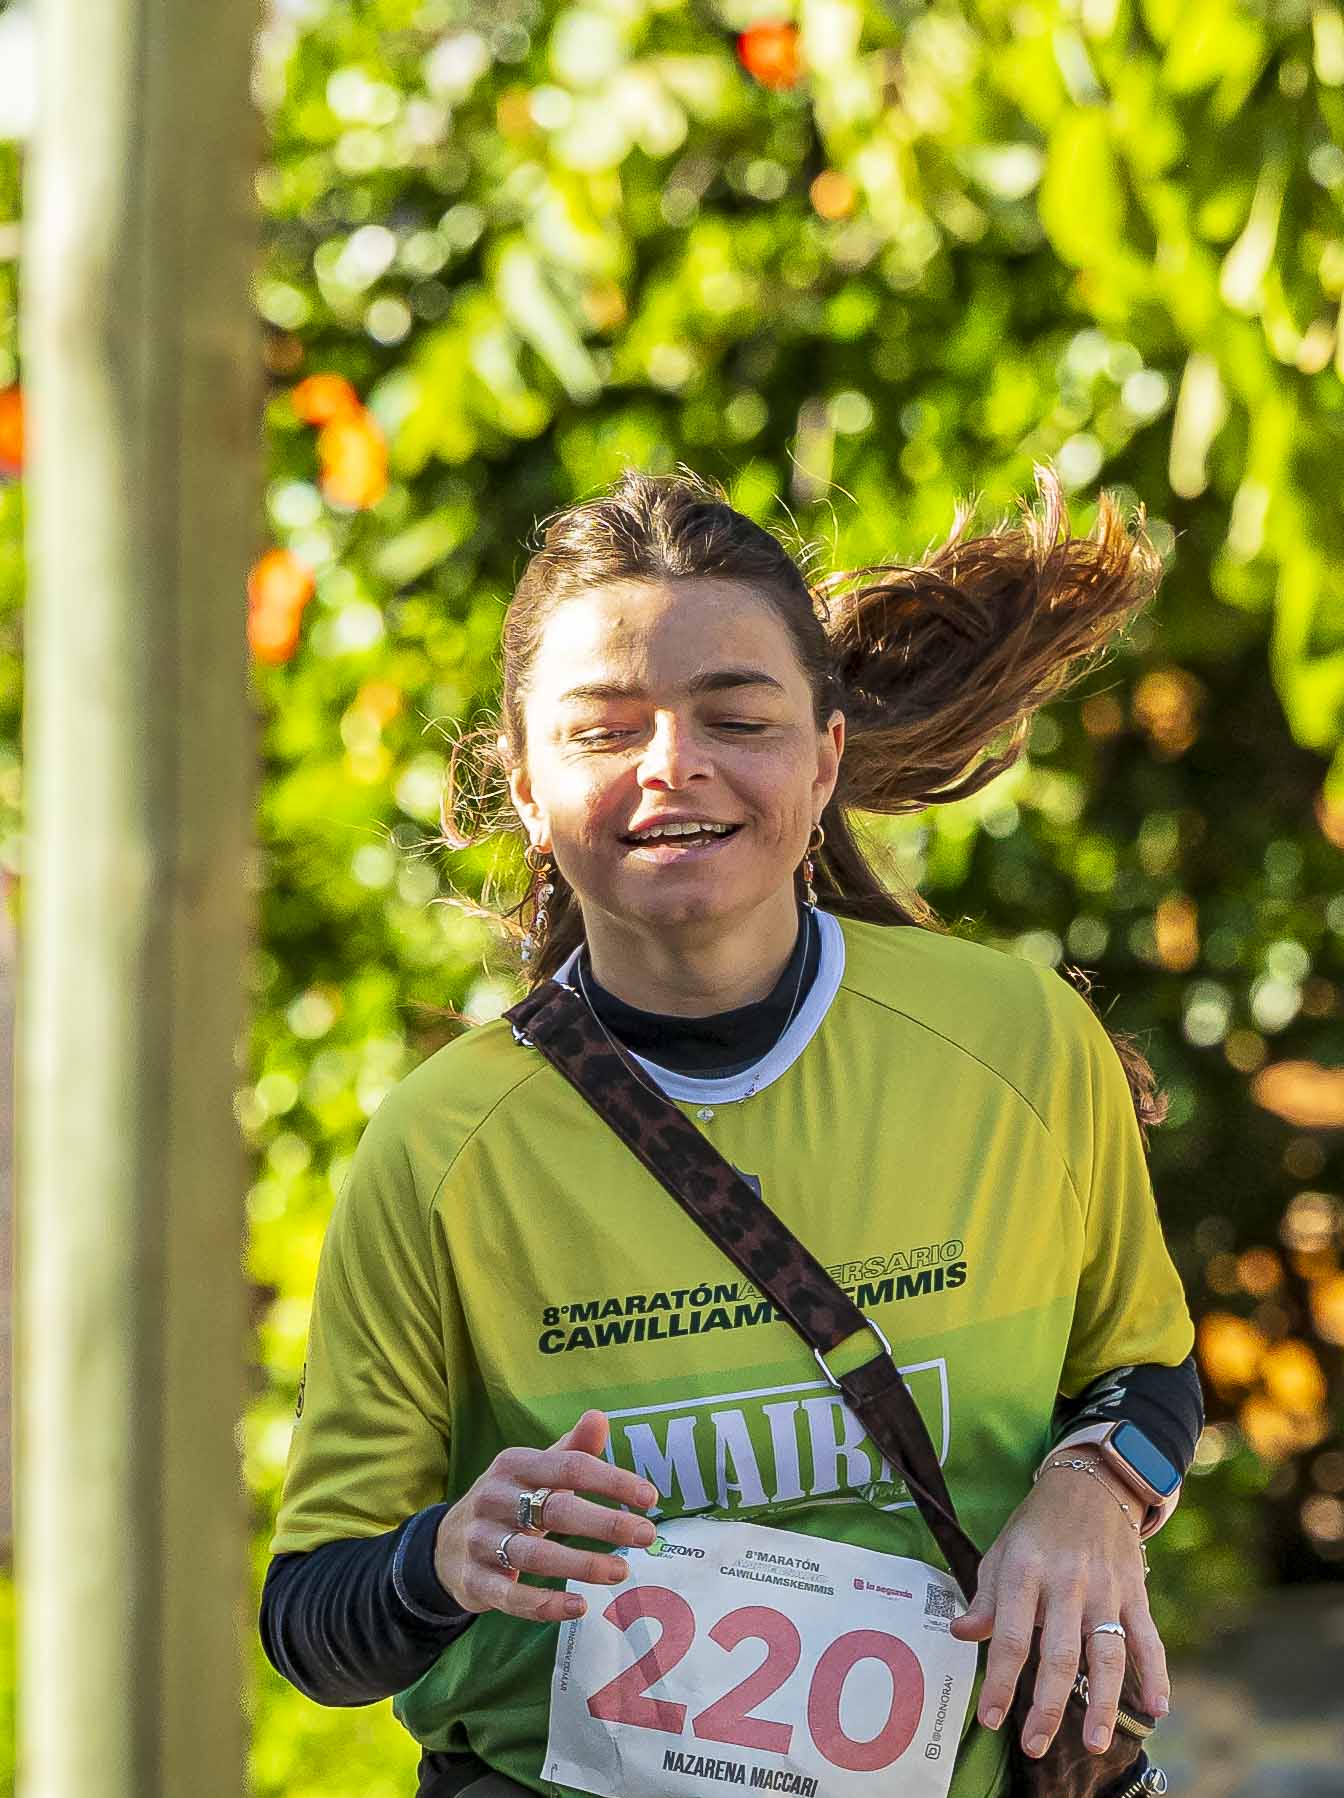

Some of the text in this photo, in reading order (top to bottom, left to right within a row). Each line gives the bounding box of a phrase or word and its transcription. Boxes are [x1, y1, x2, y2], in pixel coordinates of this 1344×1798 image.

[538, 1261, 968, 1355] CAWILLIAMMMIS
[739, 1239, 965, 1301] AERSARIO
[623, 1395, 896, 1517] MAIR
[719, 1566, 835, 1596] CAWILLIAMSKEMMIS
[586, 1585, 926, 1773] 220
[662, 1749, 819, 1798] NAZARENA MACCARI
